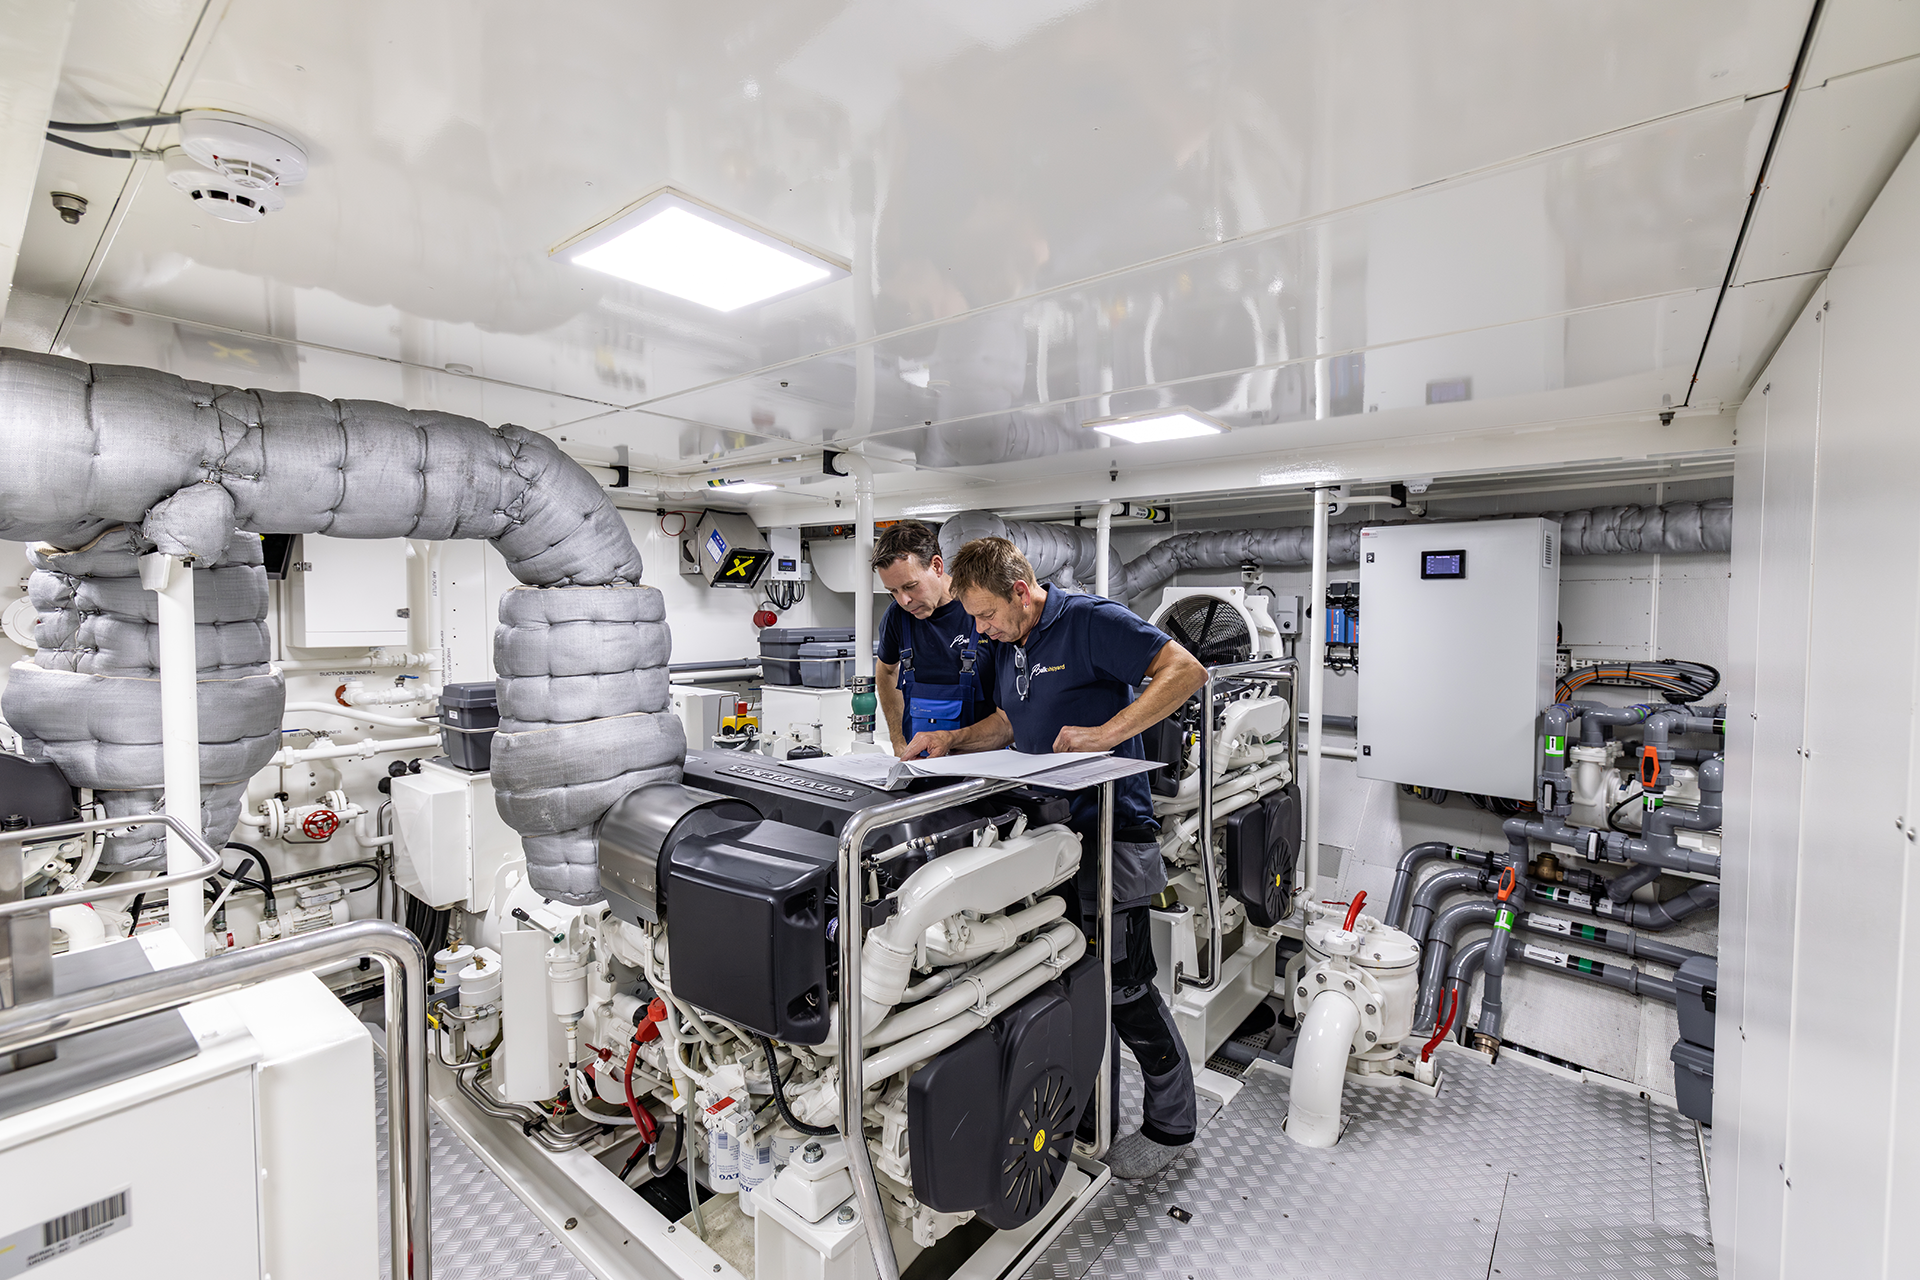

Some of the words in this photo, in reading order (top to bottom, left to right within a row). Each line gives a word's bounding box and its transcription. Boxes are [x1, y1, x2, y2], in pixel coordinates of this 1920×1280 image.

[728, 765, 791, 783] PENTA
[790, 778, 856, 797] VOLVO
[719, 1172, 740, 1180] LVO
